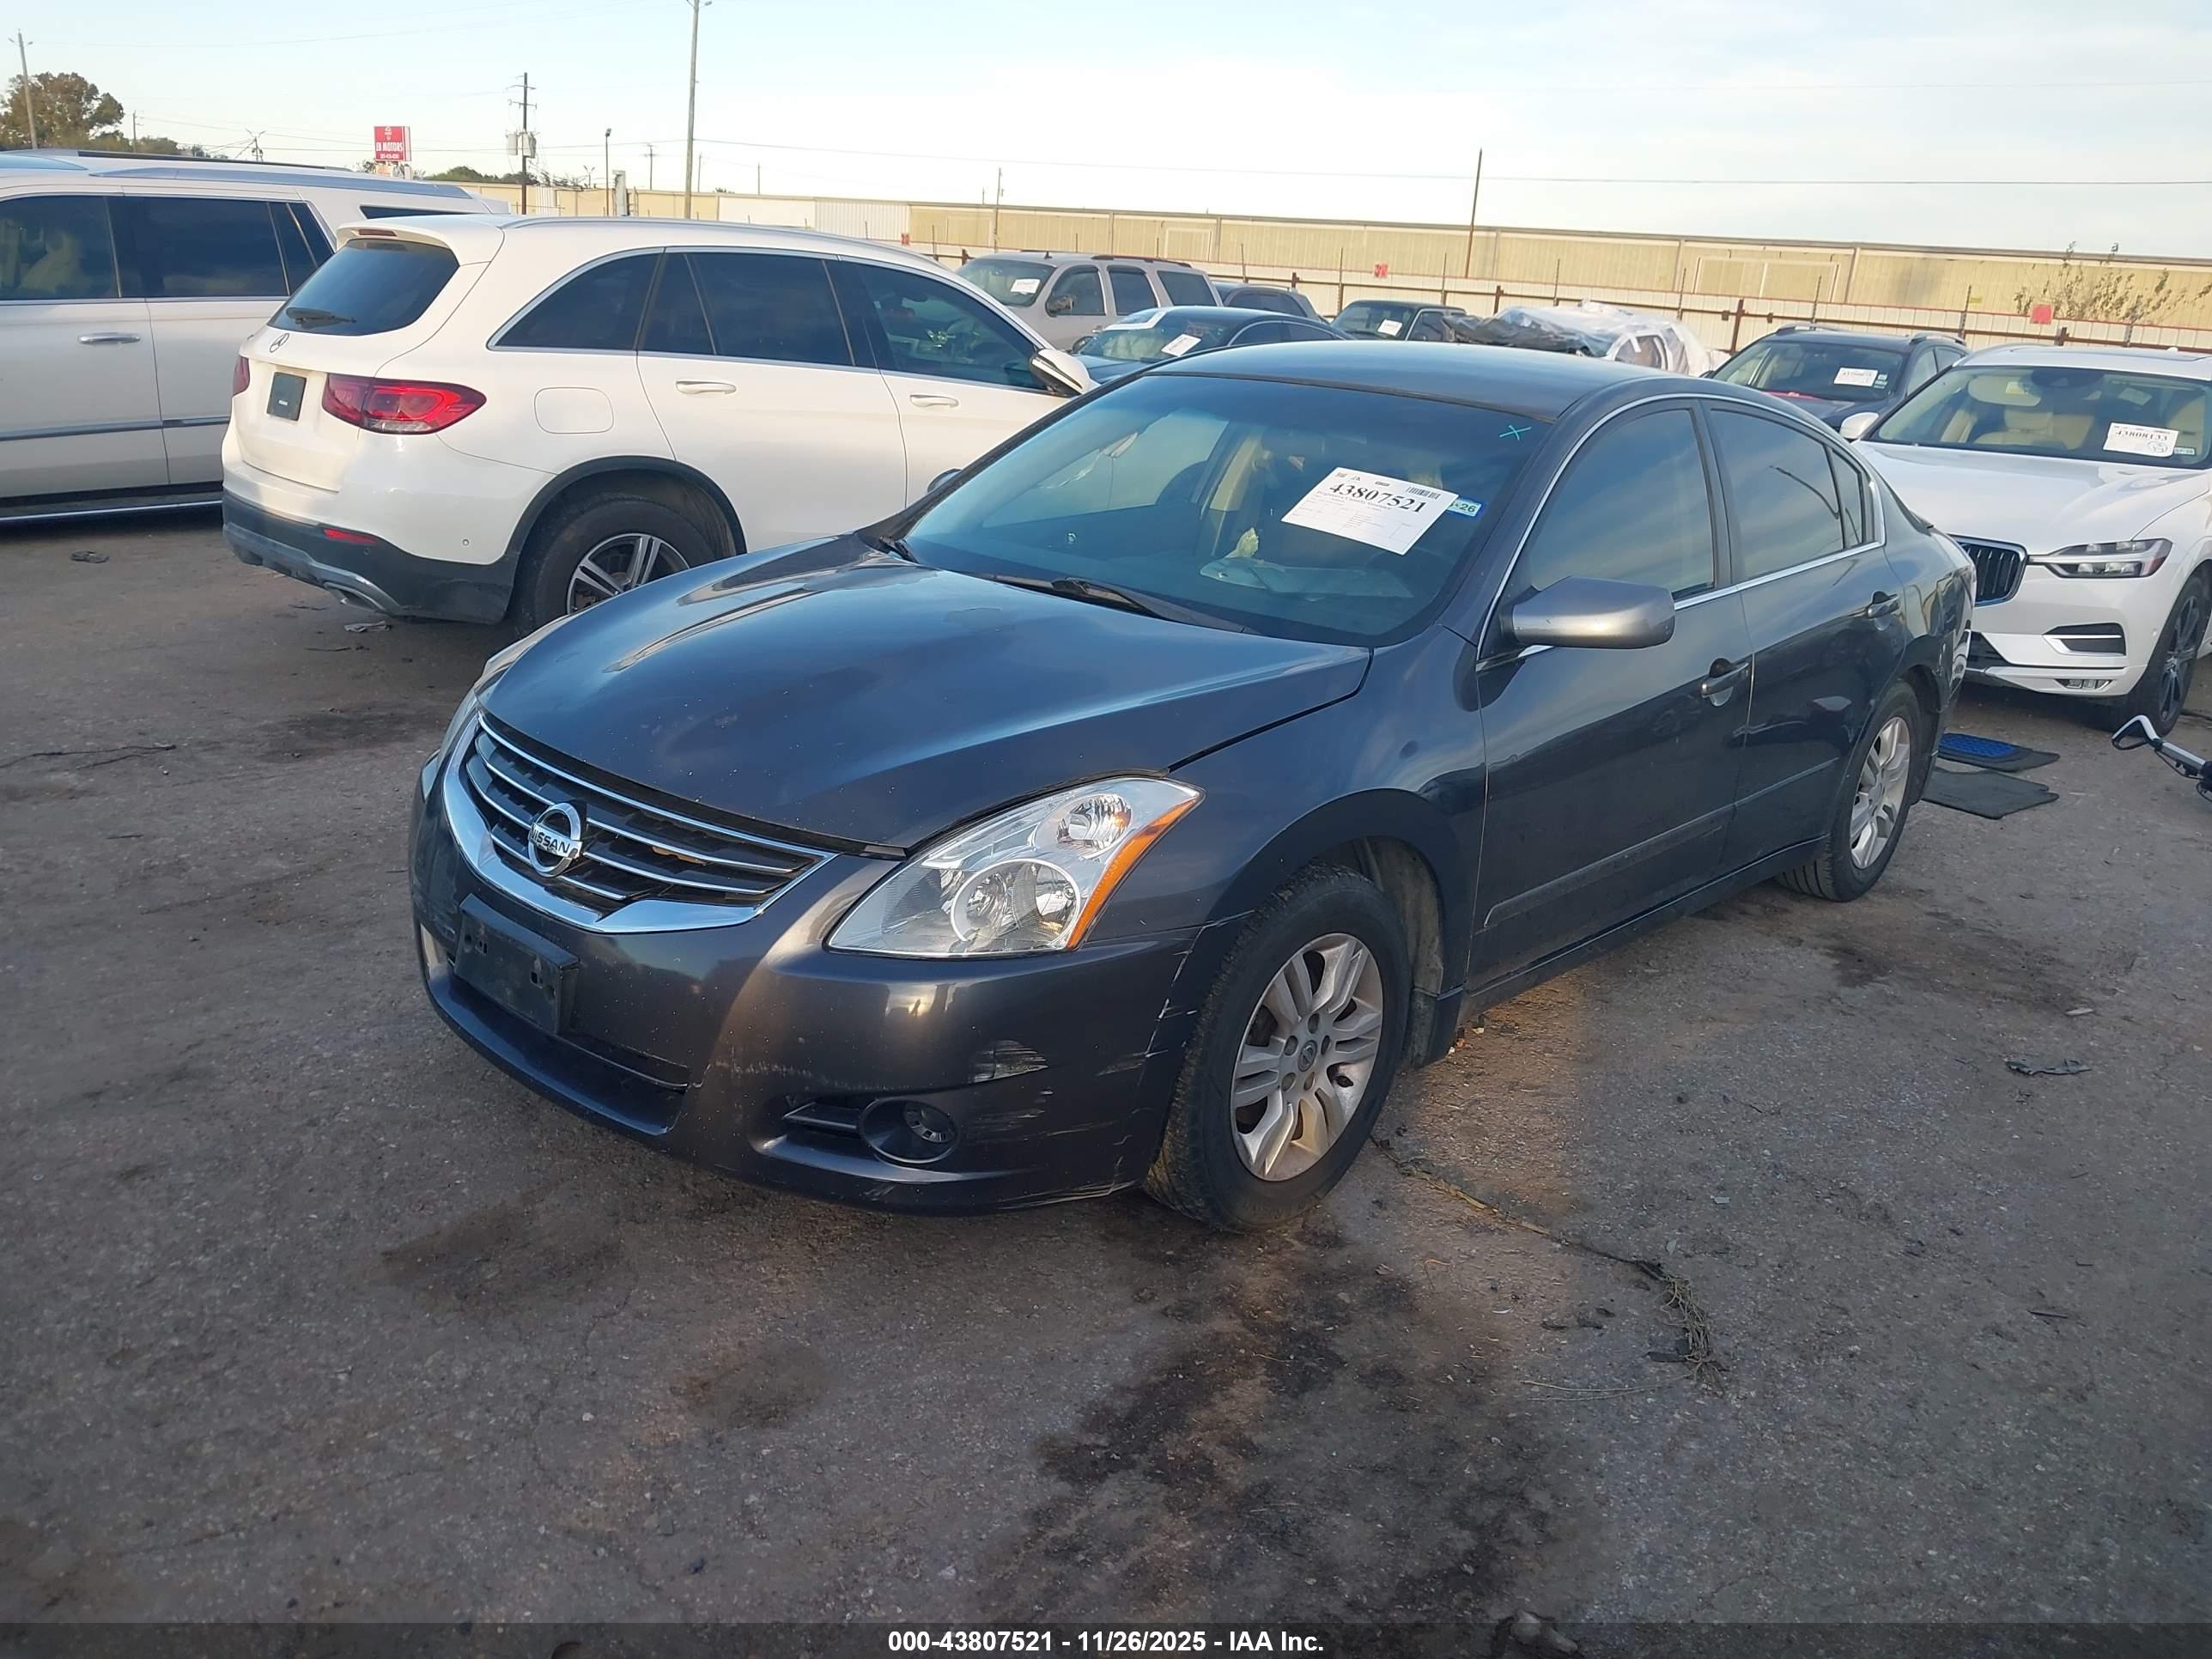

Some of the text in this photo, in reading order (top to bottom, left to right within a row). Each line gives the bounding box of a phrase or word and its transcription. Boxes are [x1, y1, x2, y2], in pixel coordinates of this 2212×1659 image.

[383, 142, 403, 151] MOTORS
[1329, 483, 1427, 514] 43807521
[531, 828, 571, 853] NISSAN
